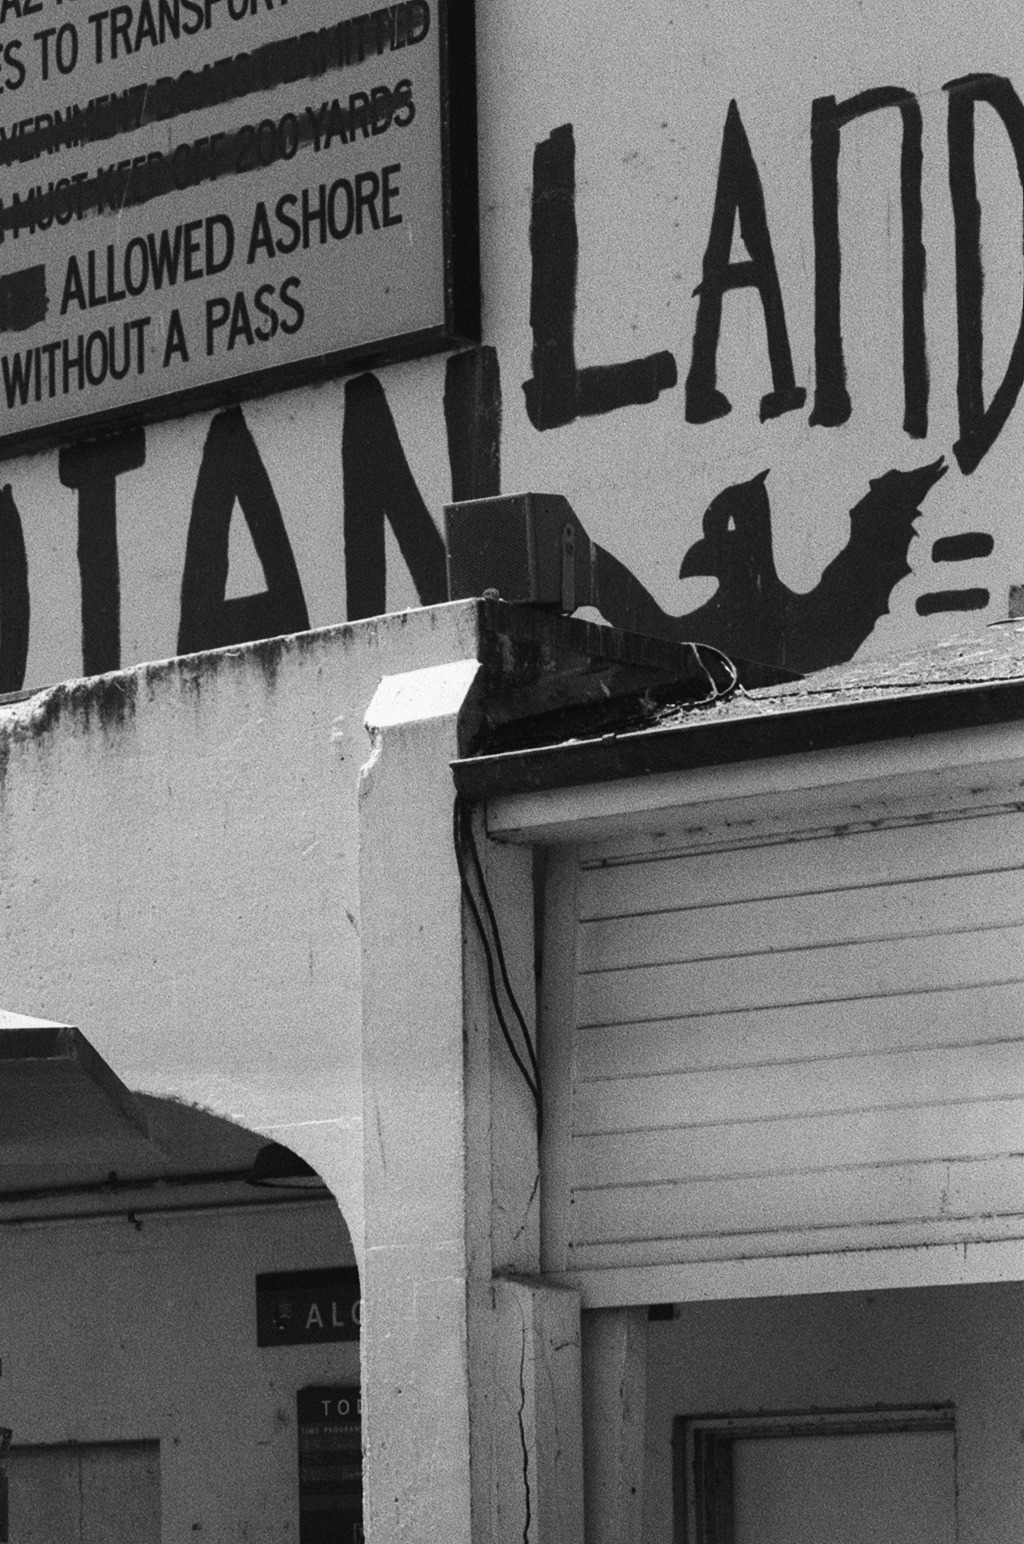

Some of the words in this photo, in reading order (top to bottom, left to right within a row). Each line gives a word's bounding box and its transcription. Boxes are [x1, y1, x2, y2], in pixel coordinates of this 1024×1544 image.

[33, 23, 78, 82] TO
[306, 80, 415, 152] YARDS
[60, 213, 235, 316] ALLOWED
[247, 163, 403, 264] ASHORE
[1, 316, 151, 408] WITHOUT
[162, 308, 189, 368] A
[205, 276, 305, 356] PASS
